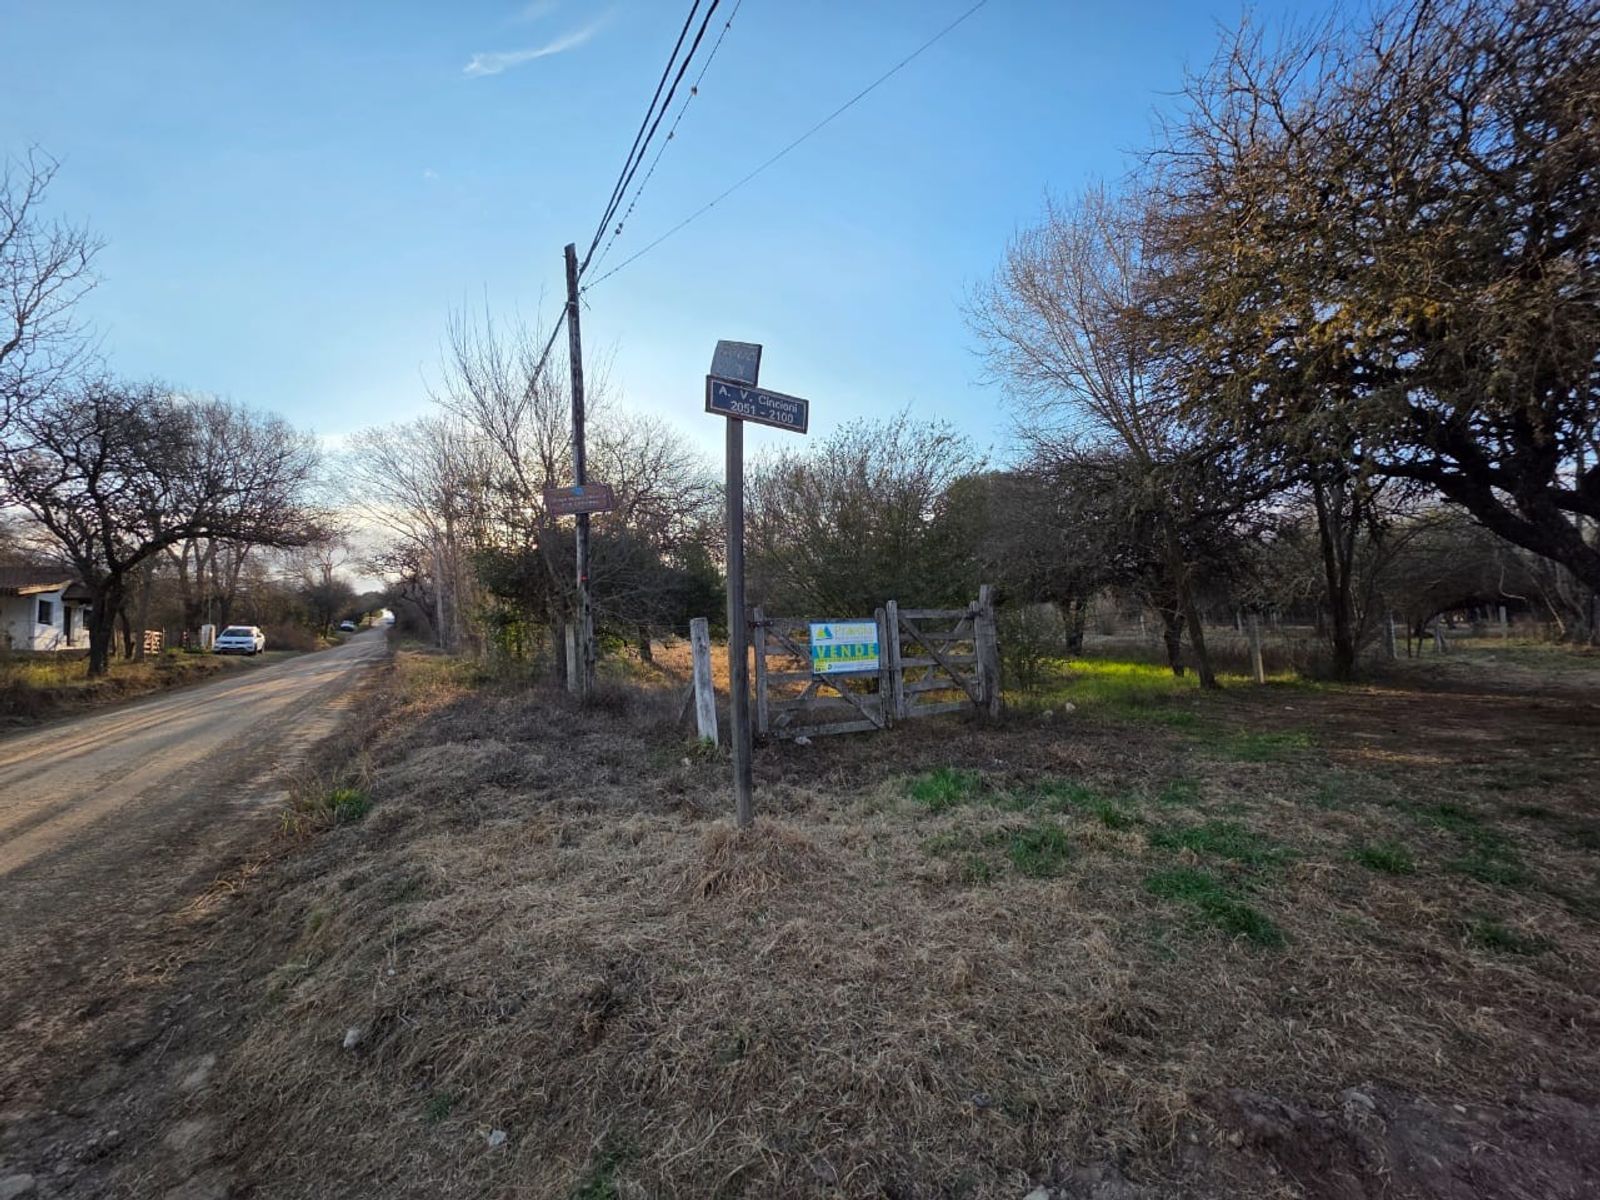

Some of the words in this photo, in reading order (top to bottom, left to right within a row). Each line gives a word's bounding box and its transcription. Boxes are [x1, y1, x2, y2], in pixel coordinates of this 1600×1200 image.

[719, 385, 731, 397] A.
[740, 391, 753, 403] V.
[758, 394, 798, 413] Cincioni
[731, 401, 755, 415] 2051
[769, 410, 794, 423] 2100
[817, 644, 875, 658] VENDE
